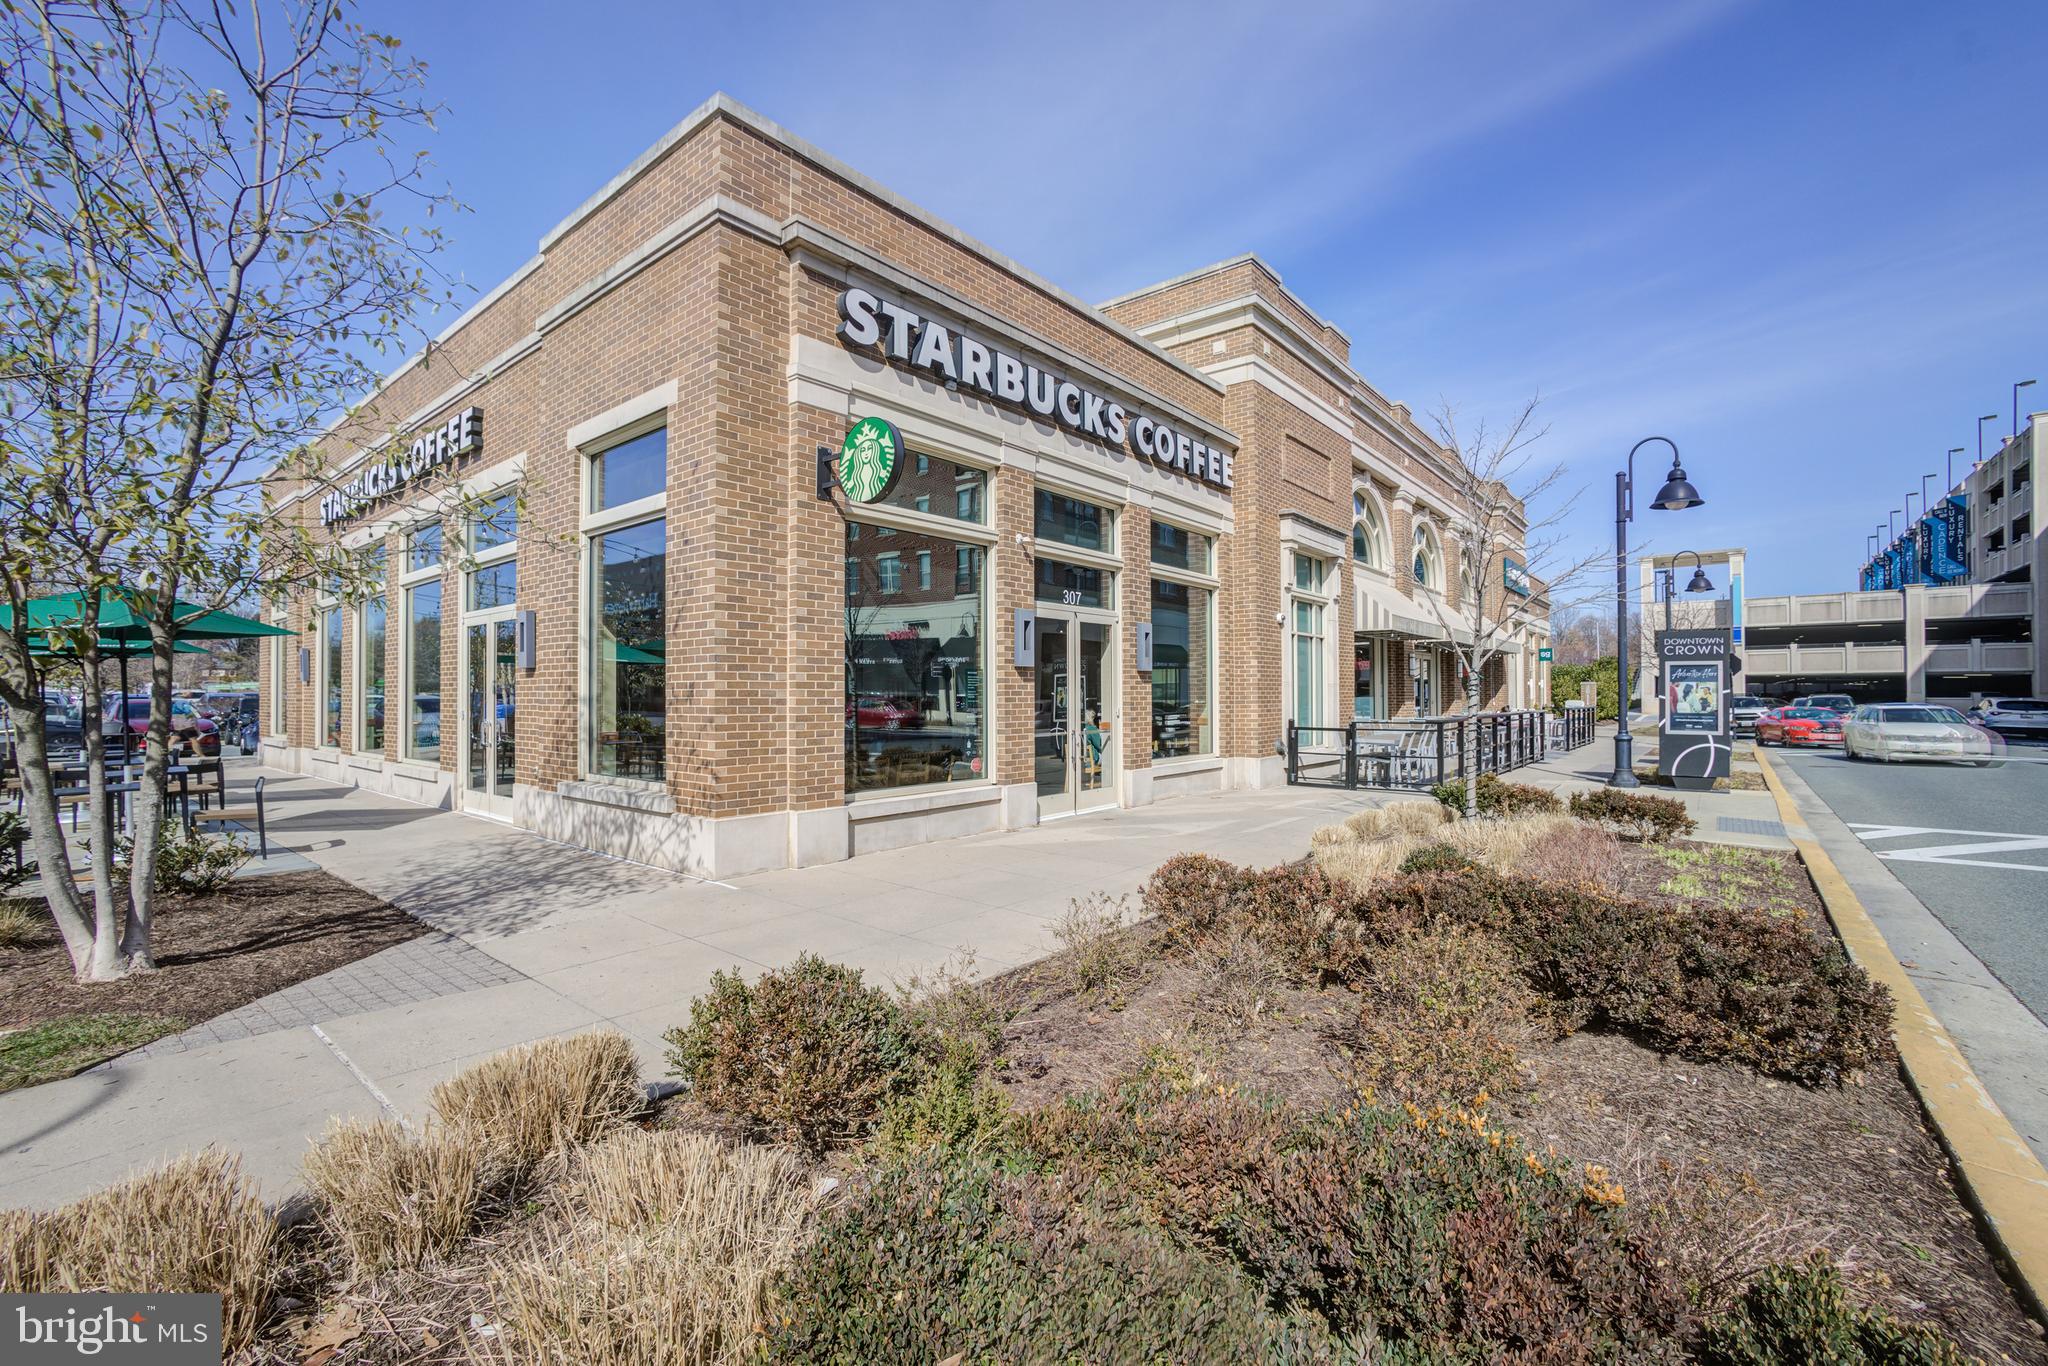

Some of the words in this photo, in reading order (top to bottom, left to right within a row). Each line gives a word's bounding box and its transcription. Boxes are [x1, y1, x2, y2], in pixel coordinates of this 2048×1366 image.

[843, 287, 1126, 445] STARBUCKS
[1134, 416, 1234, 488] COFFEE
[1938, 523, 1946, 574] CADENCE
[1948, 503, 1956, 544] LUXURY
[1957, 514, 1965, 561] RENTALS
[1063, 589, 1082, 606] 307
[1664, 637, 1724, 645] DOWNTOWN
[1664, 645, 1724, 656] CROWN
